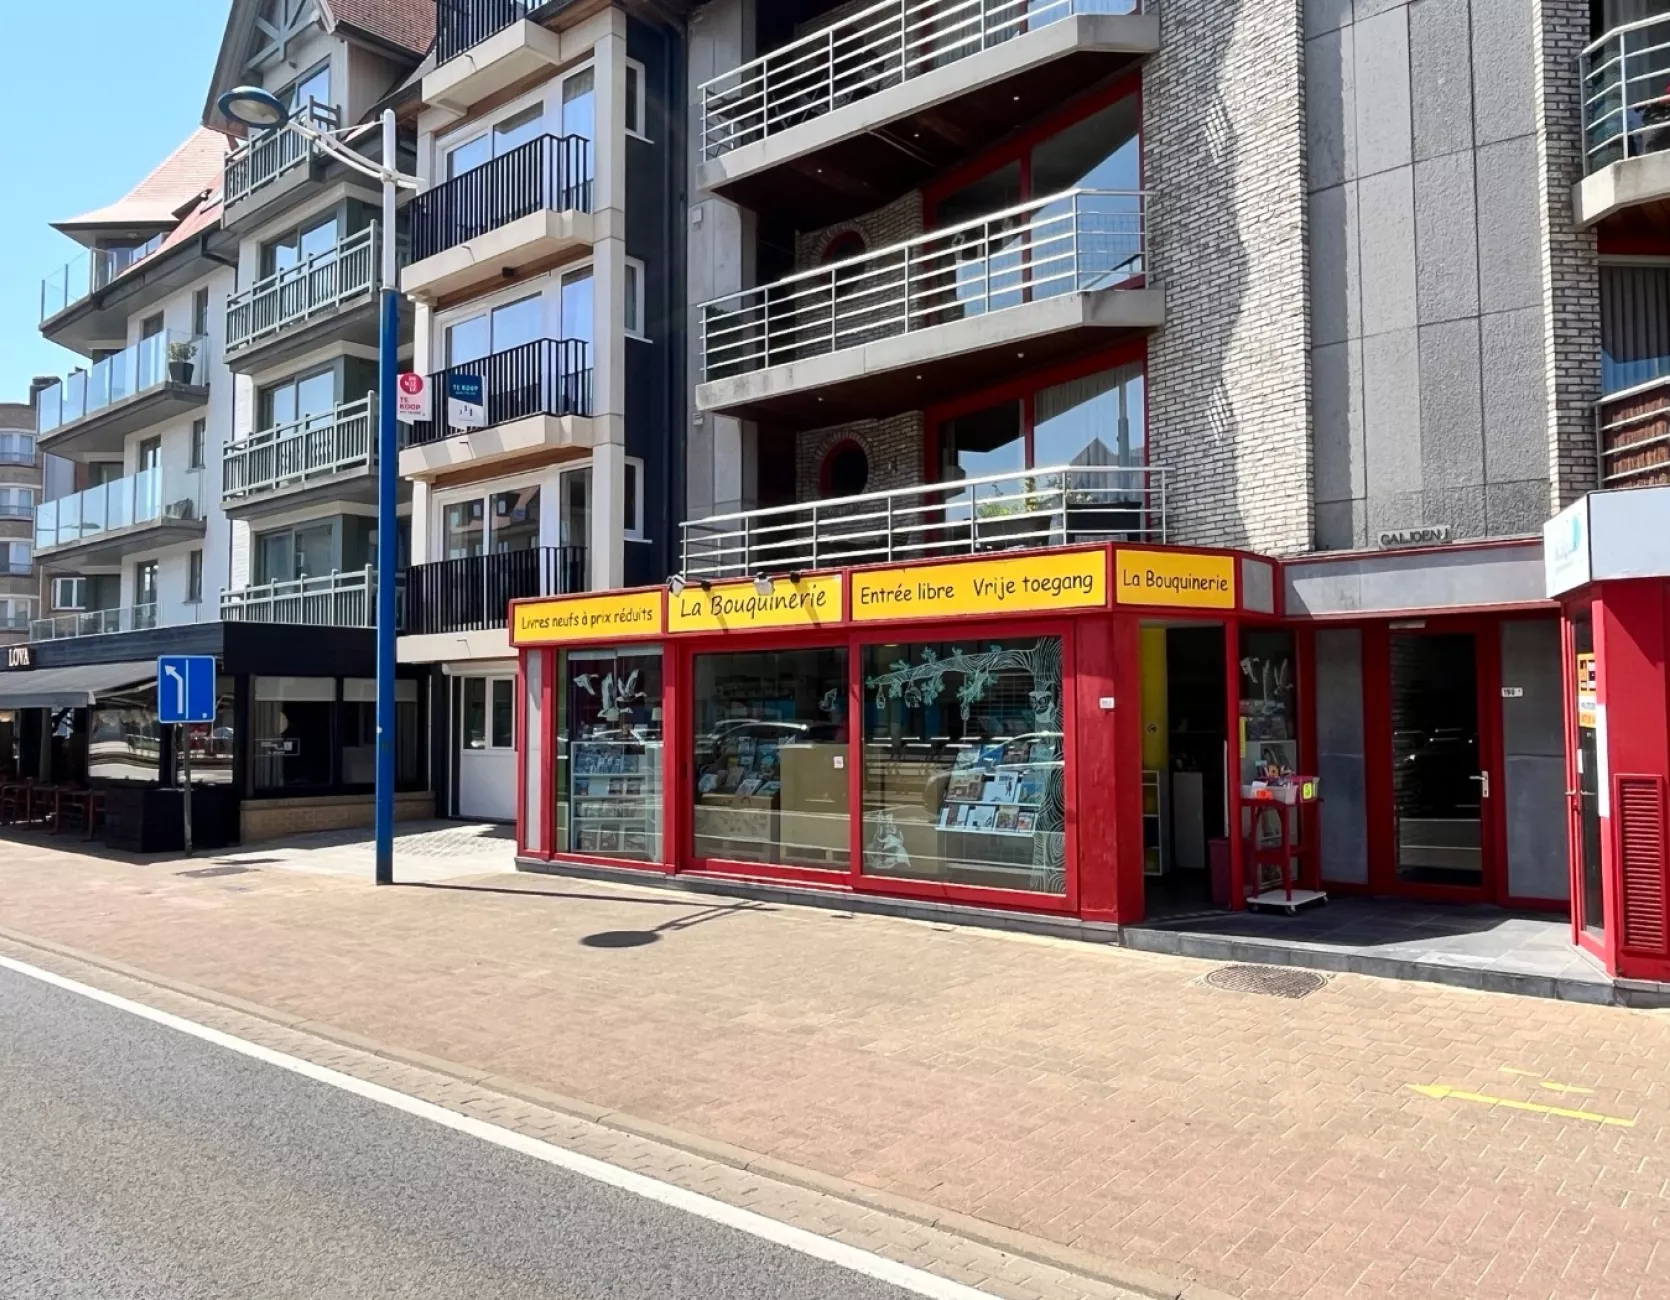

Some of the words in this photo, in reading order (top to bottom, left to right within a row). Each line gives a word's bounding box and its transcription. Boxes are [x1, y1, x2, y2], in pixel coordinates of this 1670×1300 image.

[1380, 528, 1441, 546] GALJOEN
[861, 583, 912, 604] Entrée
[918, 582, 955, 600] libre
[973, 576, 1015, 600] Vrije
[1022, 574, 1093, 596] toegang
[1123, 568, 1140, 587] La
[1146, 569, 1229, 594] Bouquinerie
[681, 598, 702, 618] La
[710, 585, 827, 619] Bouquinerie
[521, 615, 550, 630] Livres
[551, 611, 580, 628] neufs
[581, 610, 588, 626] à
[590, 611, 611, 629] prix
[613, 607, 653, 623] réduits
[8, 647, 30, 667] LOVA
